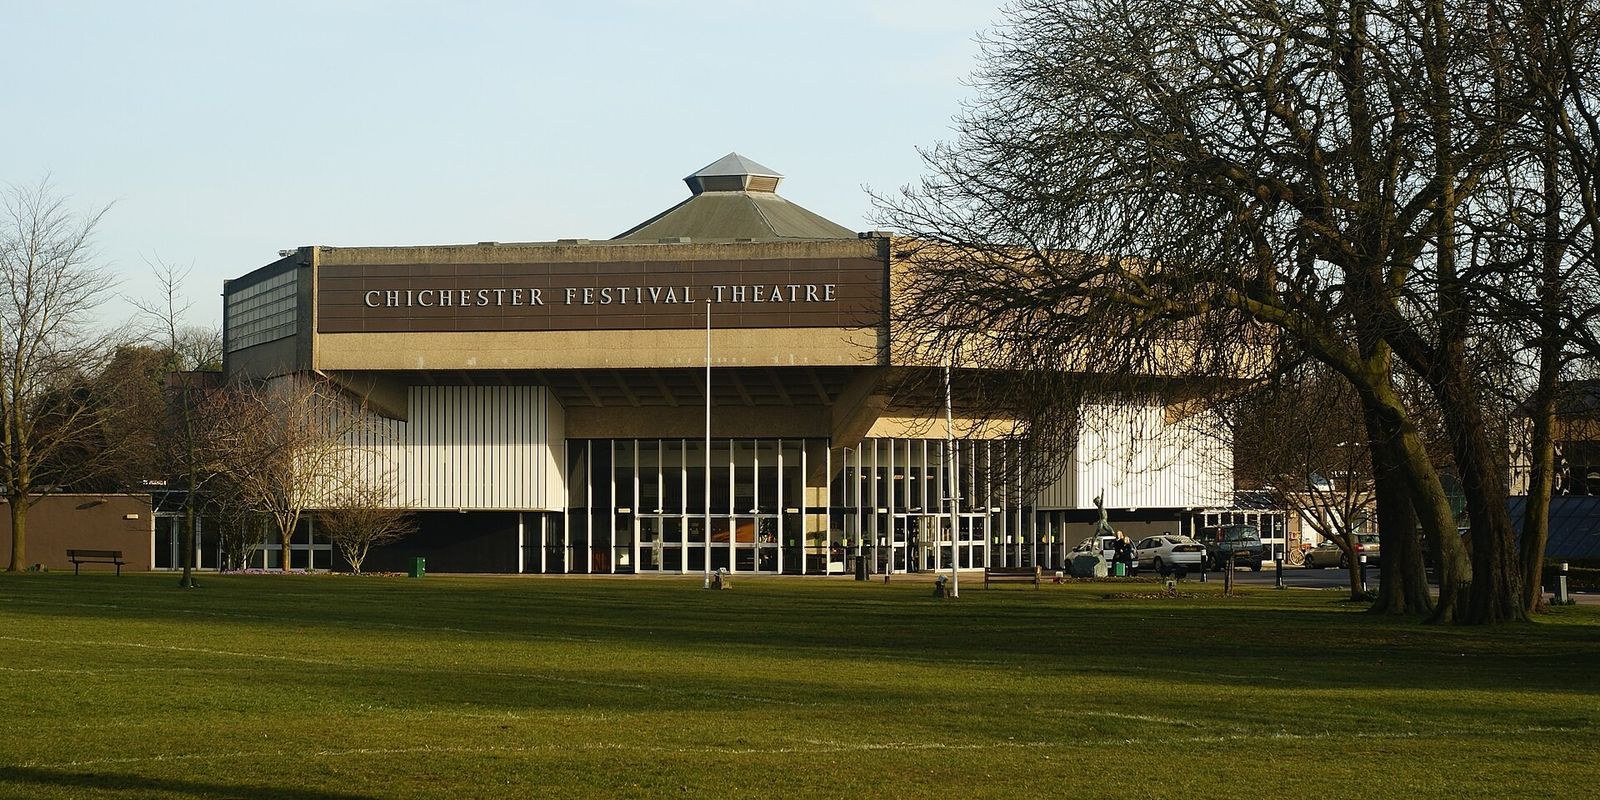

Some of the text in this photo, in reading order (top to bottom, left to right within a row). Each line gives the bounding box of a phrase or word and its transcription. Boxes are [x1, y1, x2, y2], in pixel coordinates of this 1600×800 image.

[364, 284, 837, 307] CHICHESTER FESTIVAL THEATRE
